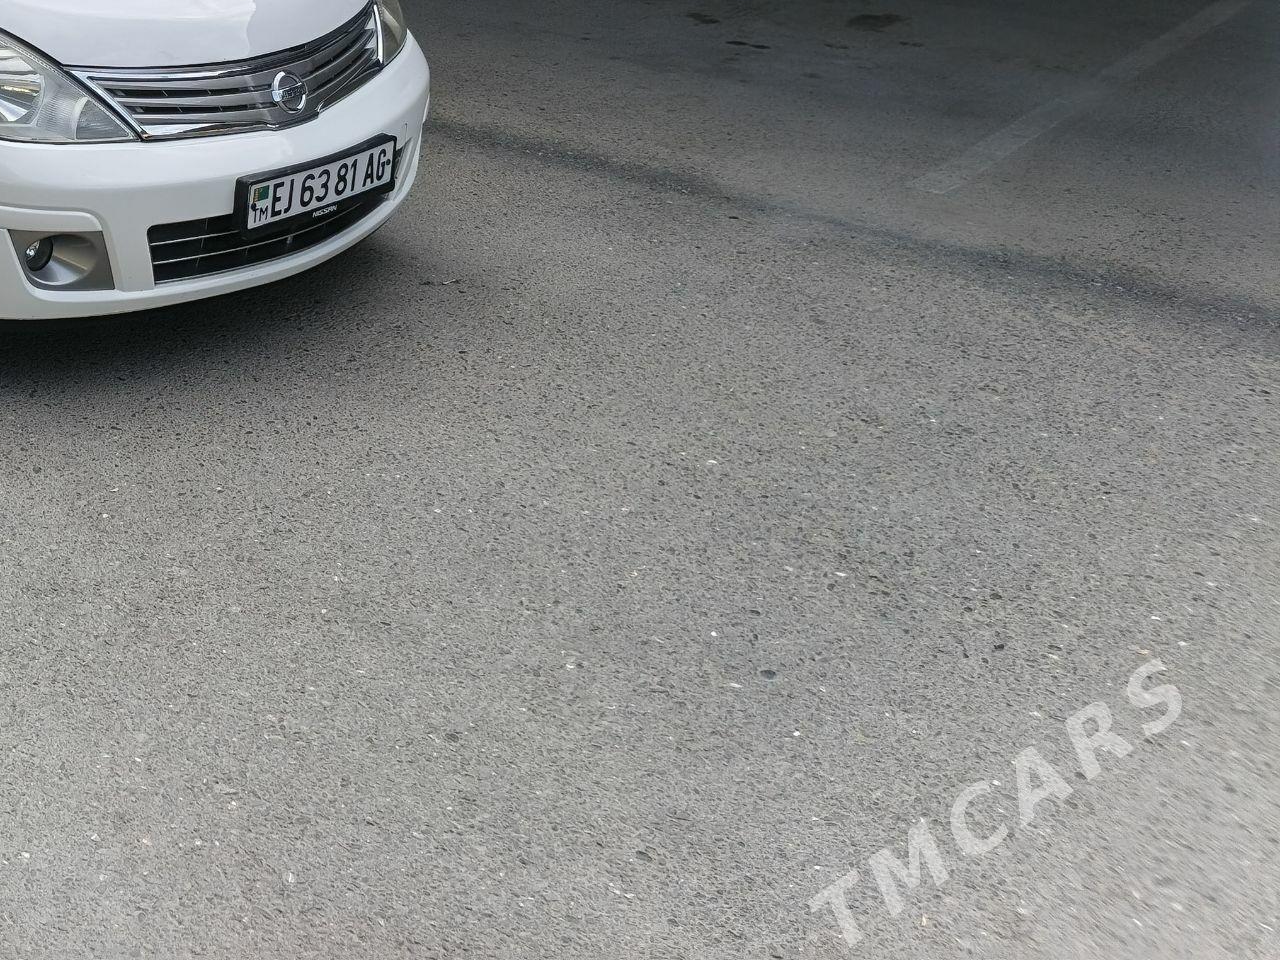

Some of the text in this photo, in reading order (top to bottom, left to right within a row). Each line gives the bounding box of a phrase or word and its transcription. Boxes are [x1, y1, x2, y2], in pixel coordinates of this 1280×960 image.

[271, 148, 387, 218] EJ 63 81 AG
[252, 205, 269, 224] TM
